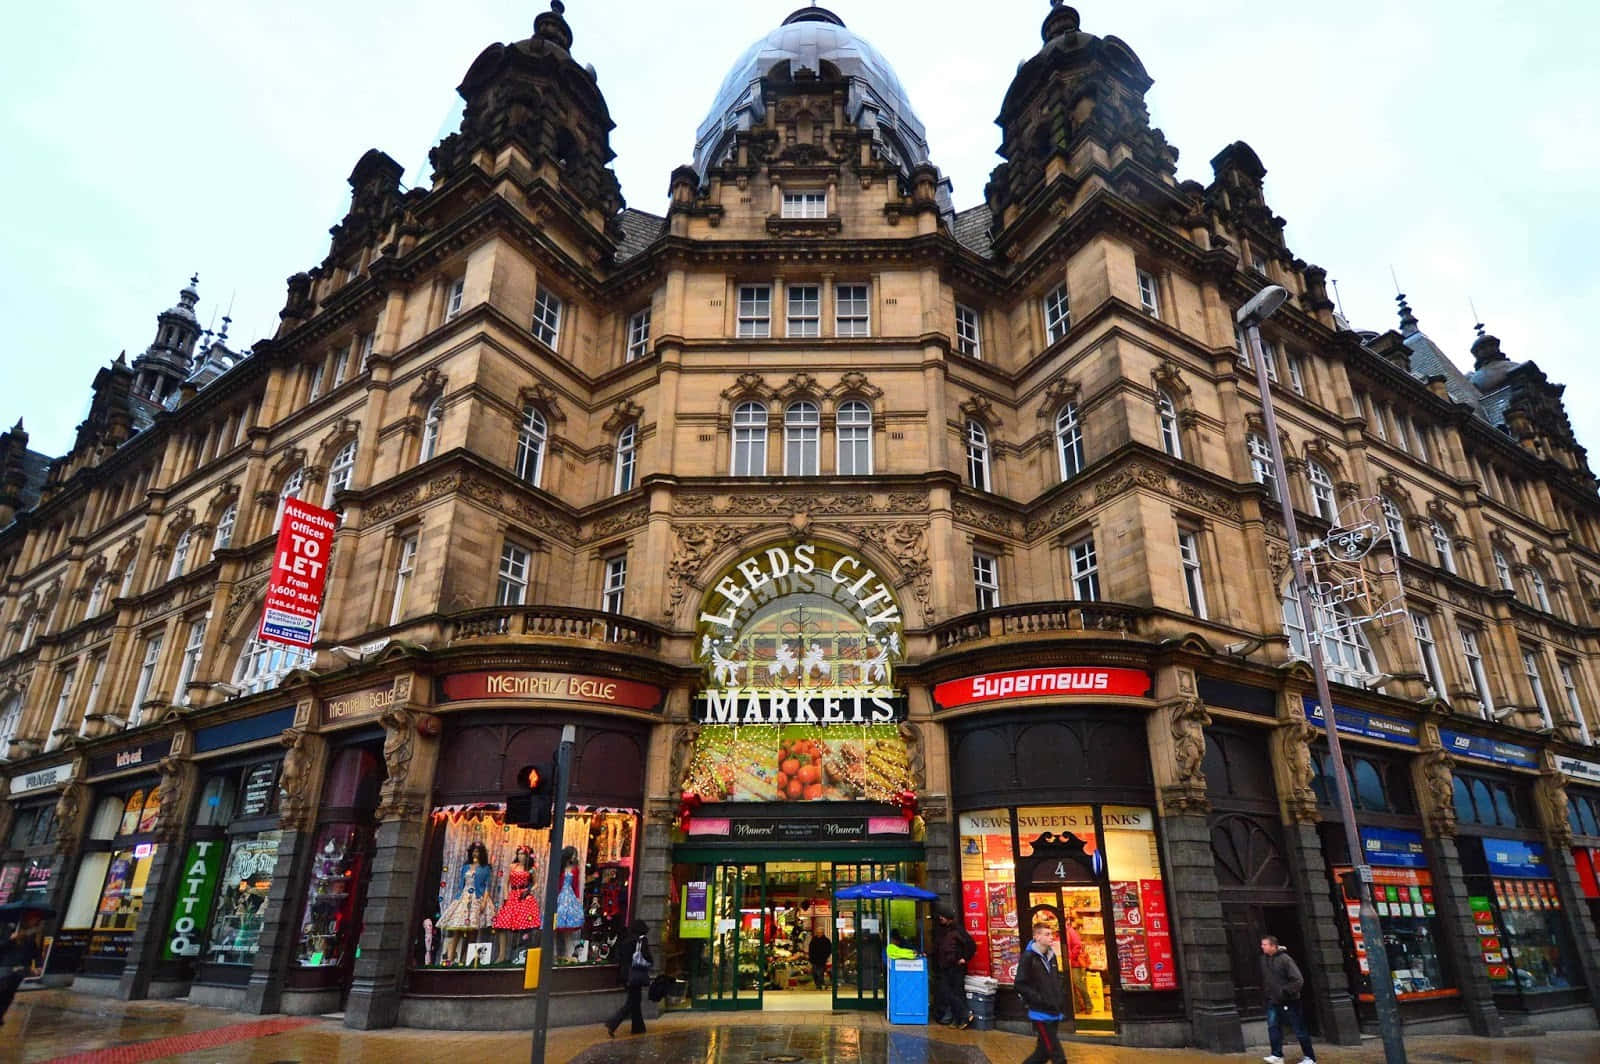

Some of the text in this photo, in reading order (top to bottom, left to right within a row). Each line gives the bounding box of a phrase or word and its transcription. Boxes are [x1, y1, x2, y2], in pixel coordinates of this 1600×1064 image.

[285, 505, 335, 530] Attractive
[291, 521, 325, 540] Offices
[291, 534, 320, 558] TO
[278, 551, 323, 579] LET
[270, 583, 297, 598] 1,600
[287, 575, 309, 589] From
[701, 544, 901, 628] LEEDS CITY
[487, 674, 617, 700] MEMPHIS BELLE
[971, 672, 1109, 698] Supernews
[703, 688, 894, 723] MARKETS
[970, 813, 1142, 829] NEWS SWEETS DINKS
[1054, 861, 1066, 879] 4
[169, 841, 214, 954] TATTOO
